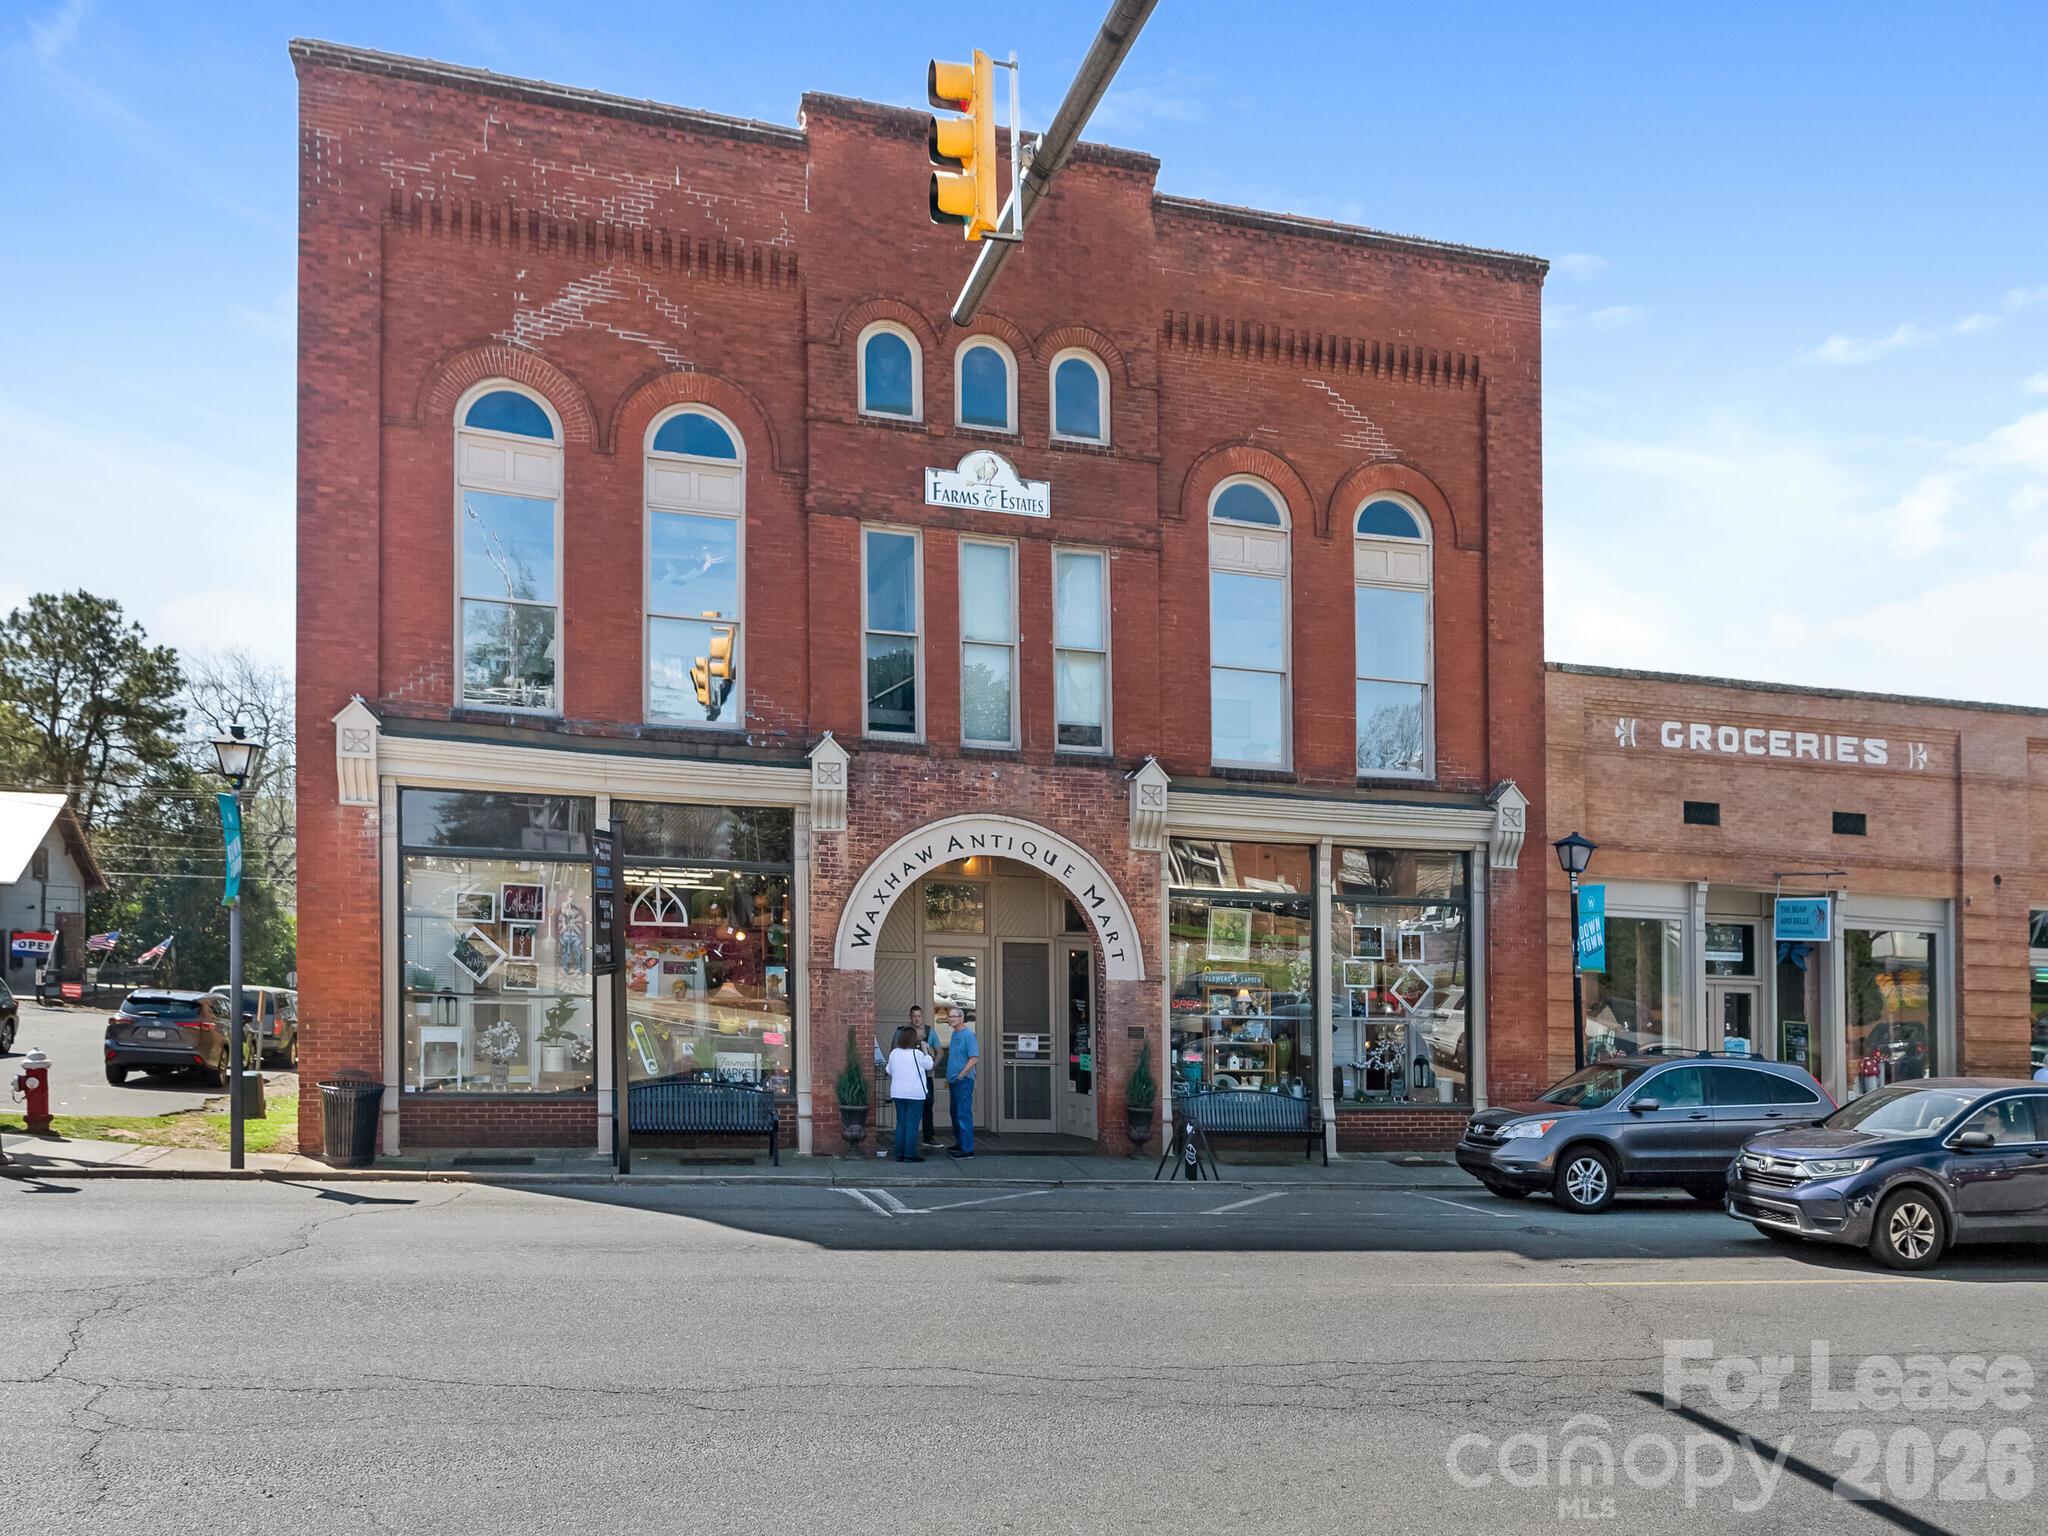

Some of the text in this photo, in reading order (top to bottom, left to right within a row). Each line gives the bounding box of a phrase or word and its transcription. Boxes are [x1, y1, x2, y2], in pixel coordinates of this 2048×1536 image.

[932, 482, 1044, 513] FARMS & ESTATES
[1661, 721, 1888, 765] GROCERIES
[851, 834, 1125, 962] WAXHAW ANTIQUE MART
[1579, 917, 1601, 940] DOWN
[1581, 932, 1604, 953] TOWN
[1171, 1000, 1202, 1009] OPEN
